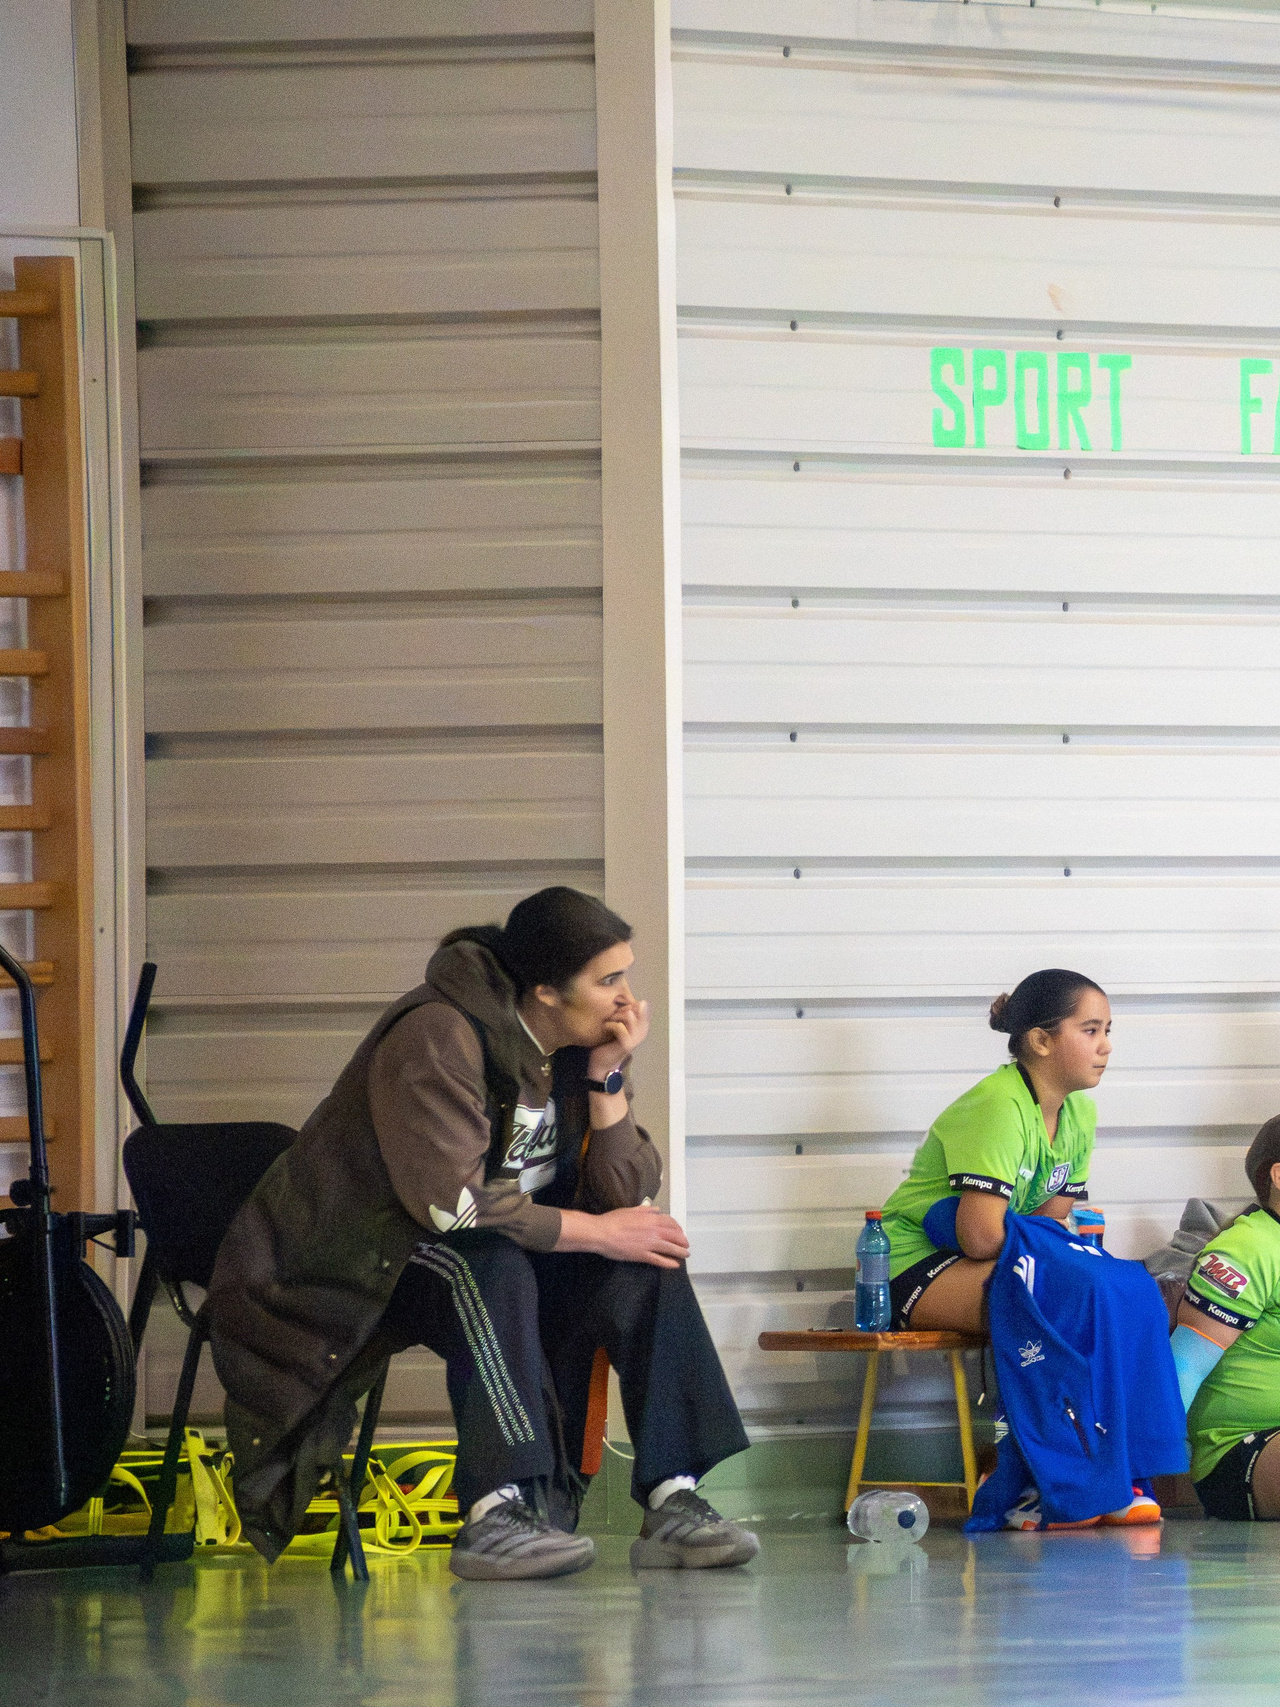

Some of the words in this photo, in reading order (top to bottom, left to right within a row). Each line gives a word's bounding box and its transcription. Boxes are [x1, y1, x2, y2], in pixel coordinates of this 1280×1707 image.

[929, 346, 1133, 452] SPORT
[961, 1175, 993, 1190] Kempa
[901, 1285, 922, 1315] Kempa
[1207, 1303, 1240, 1325] Kempa
